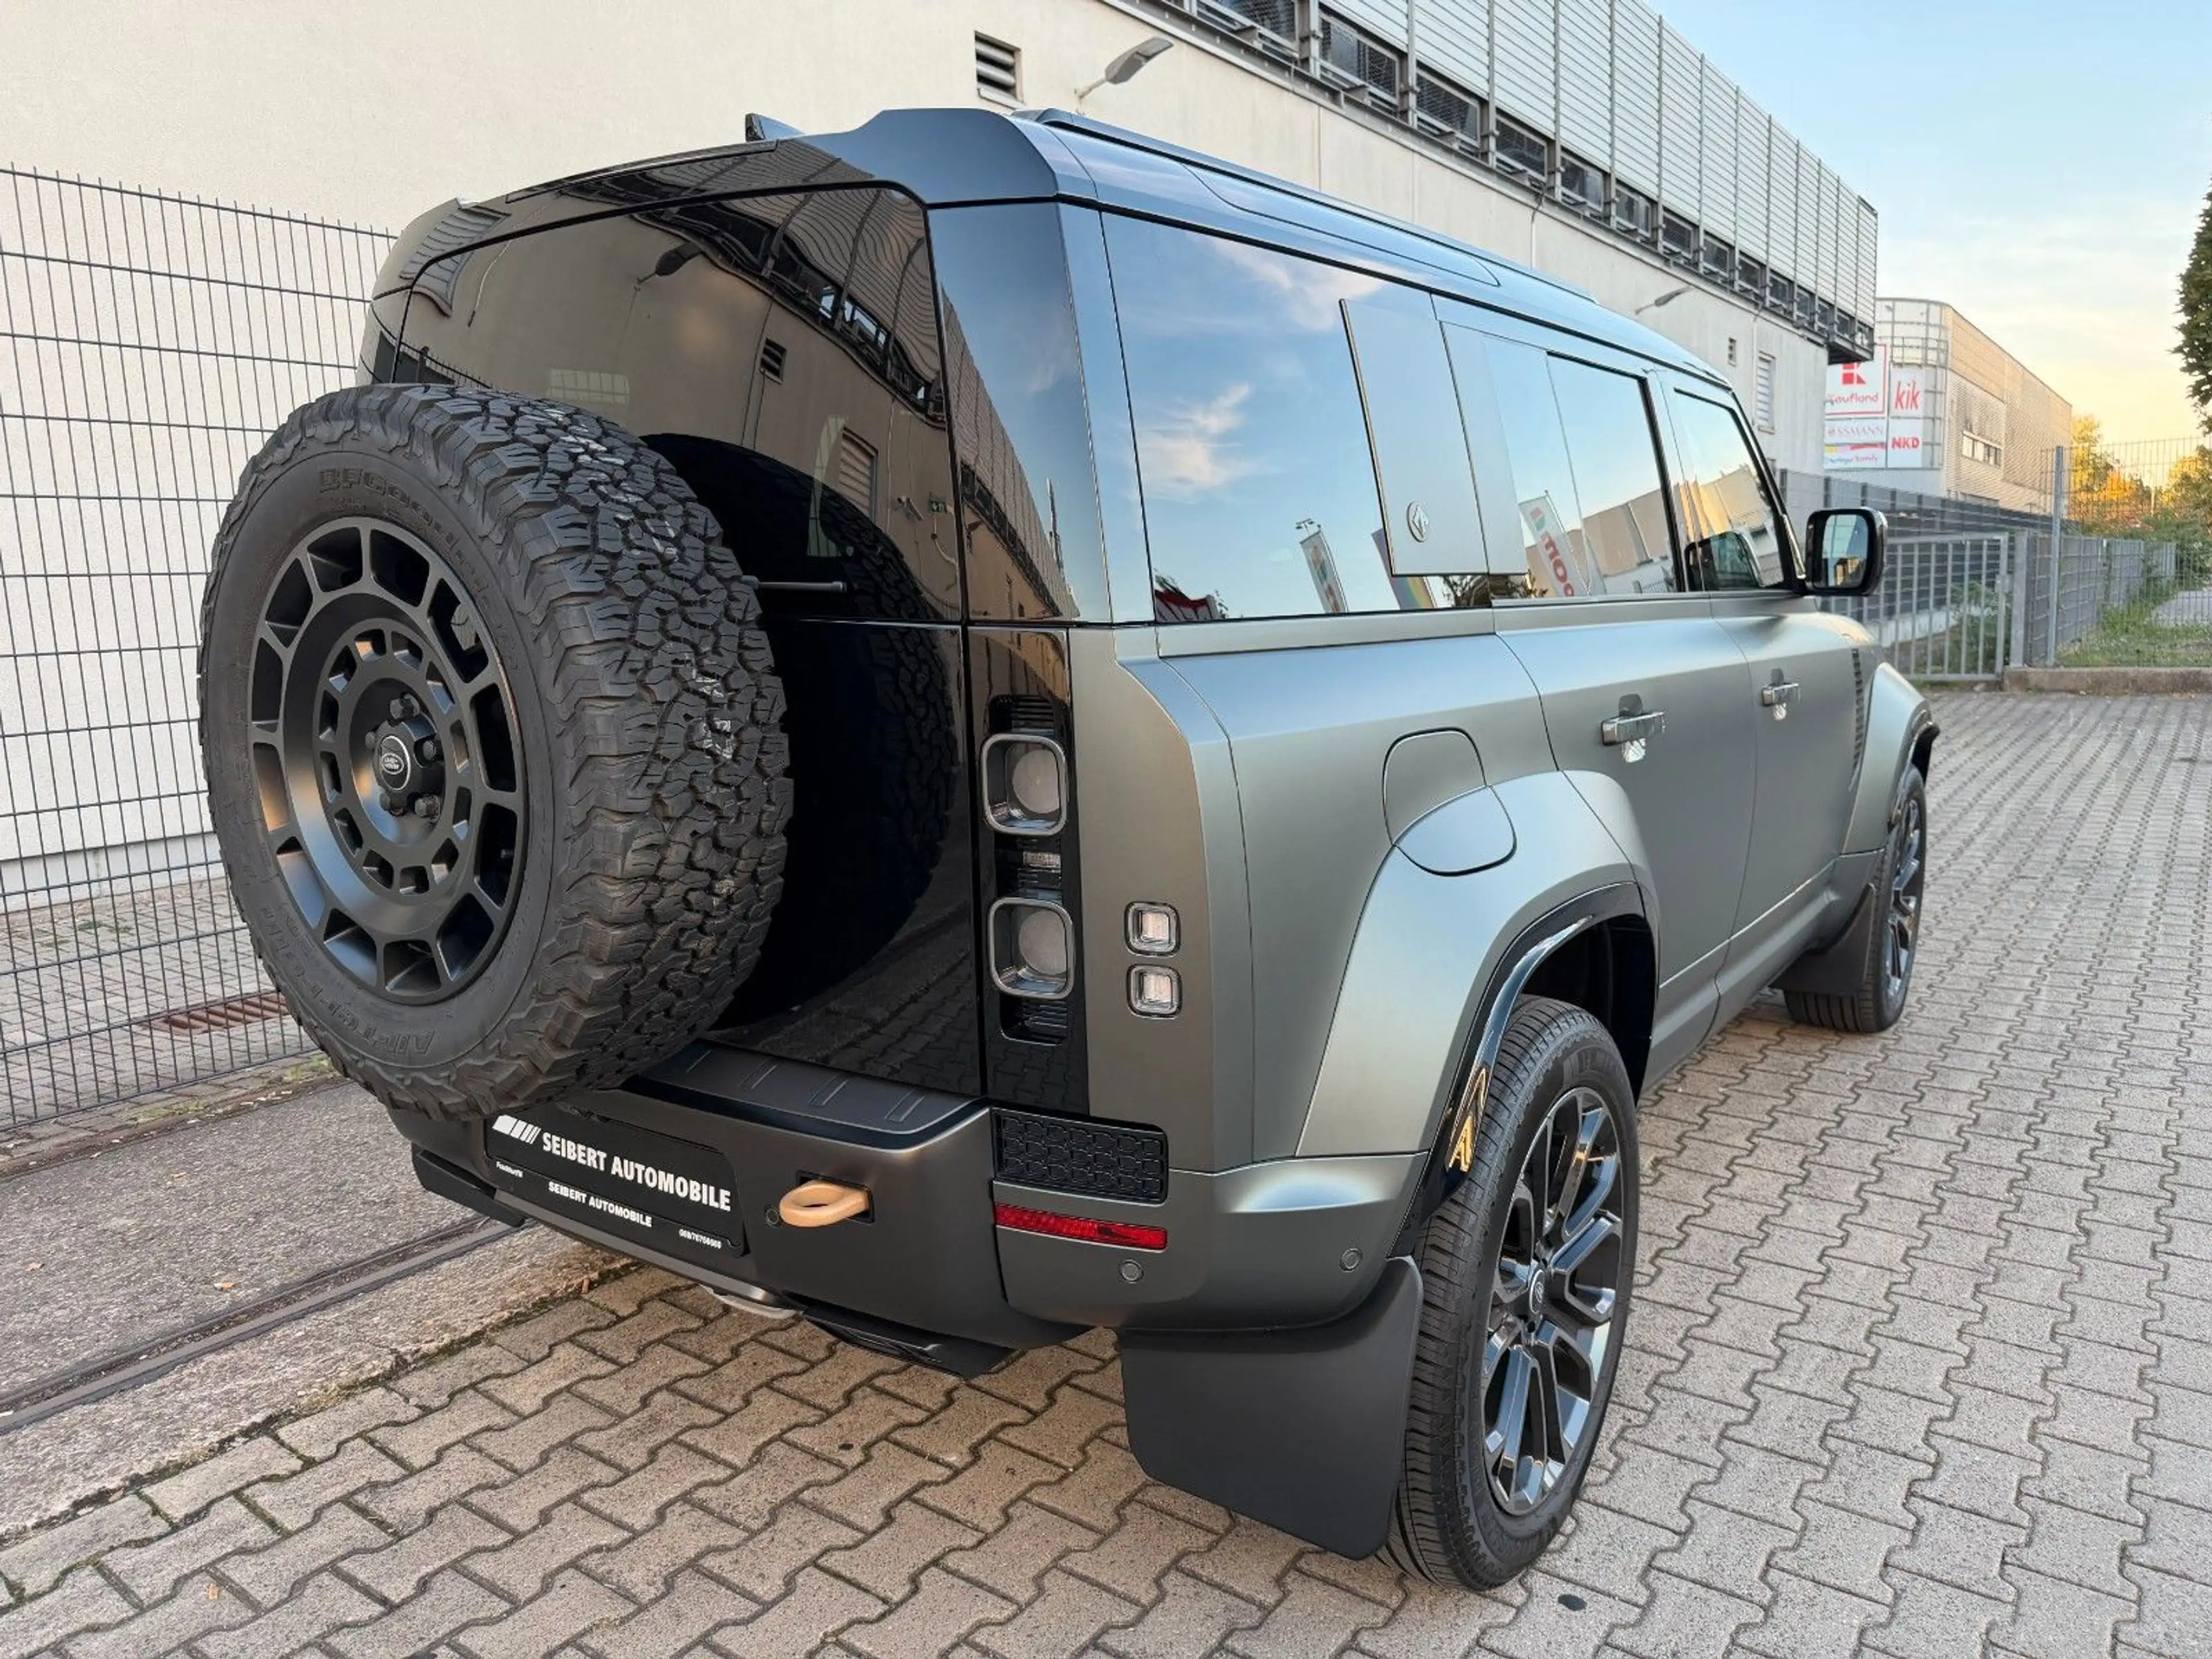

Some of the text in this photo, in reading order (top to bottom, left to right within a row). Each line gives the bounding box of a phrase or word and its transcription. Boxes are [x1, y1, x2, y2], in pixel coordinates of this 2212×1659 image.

[1894, 380, 1919, 410] kik
[1892, 436, 1920, 449] NKD
[543, 1132, 731, 1212] SEIBERT AUTOMOBILE
[548, 1181, 652, 1228] SEIBERT AUTOMOBILE
